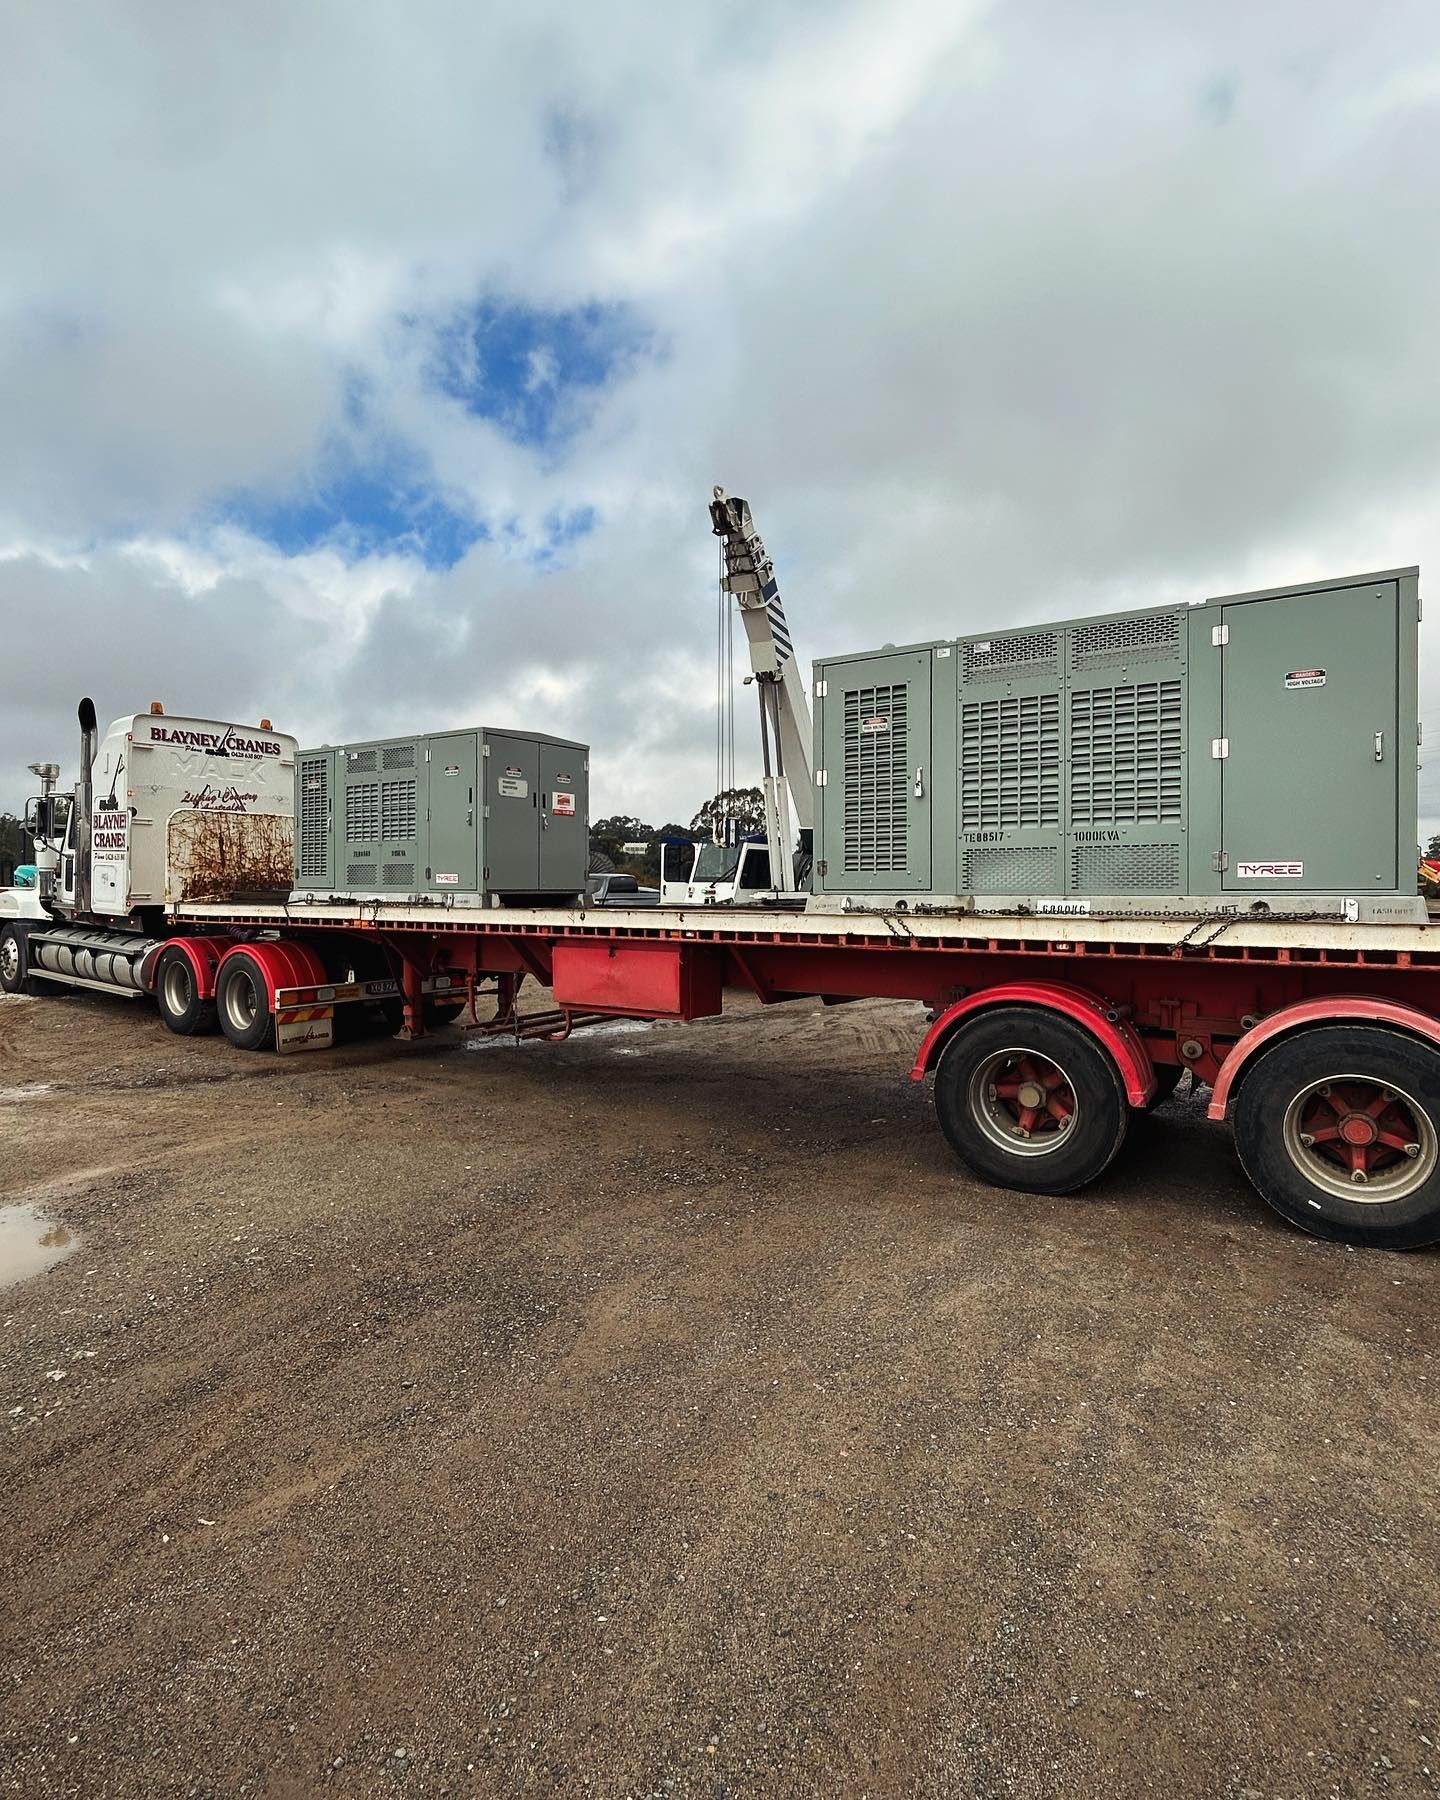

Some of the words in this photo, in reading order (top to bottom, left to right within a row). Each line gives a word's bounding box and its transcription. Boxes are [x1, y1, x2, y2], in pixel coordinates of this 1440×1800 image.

[150, 727, 220, 747] BLAYNEY
[226, 737, 280, 755] CRANES
[963, 831, 1005, 842] TE88517
[1238, 864, 1302, 875] TYREE
